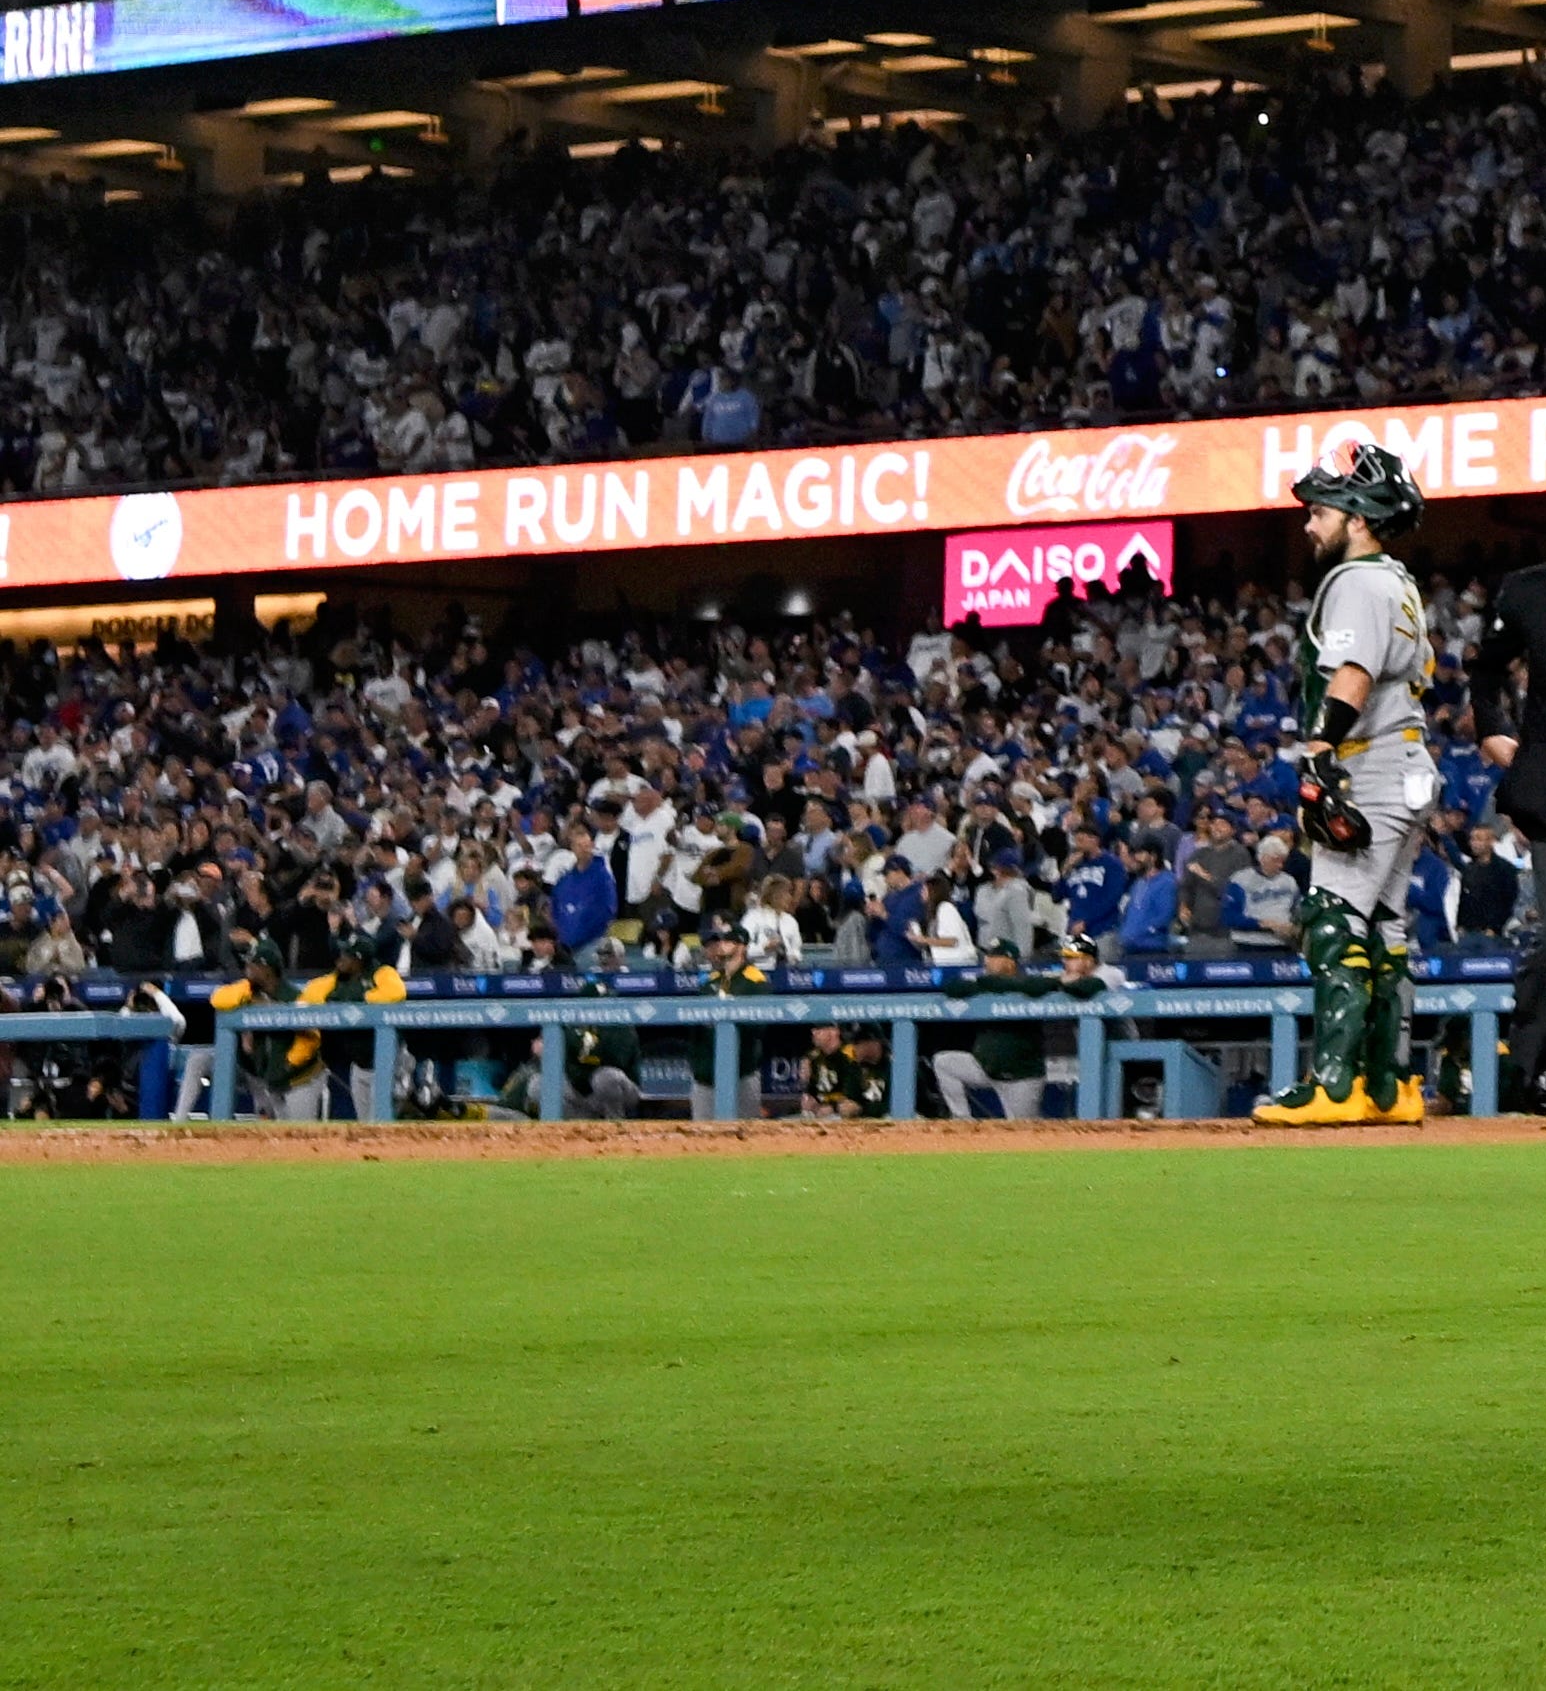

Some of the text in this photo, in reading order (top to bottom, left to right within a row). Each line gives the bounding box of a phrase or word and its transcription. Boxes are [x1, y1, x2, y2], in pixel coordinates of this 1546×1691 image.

[3, 2, 95, 82] RUN!
[285, 451, 931, 561] HOME RUN MAGIC!
[960, 540, 1107, 587] DAISO
[961, 588, 1032, 611] JAPAN
[991, 1003, 1026, 1017] BANK
[1157, 1001, 1192, 1015] BANK
[1214, 999, 1273, 1014] AMERICA
